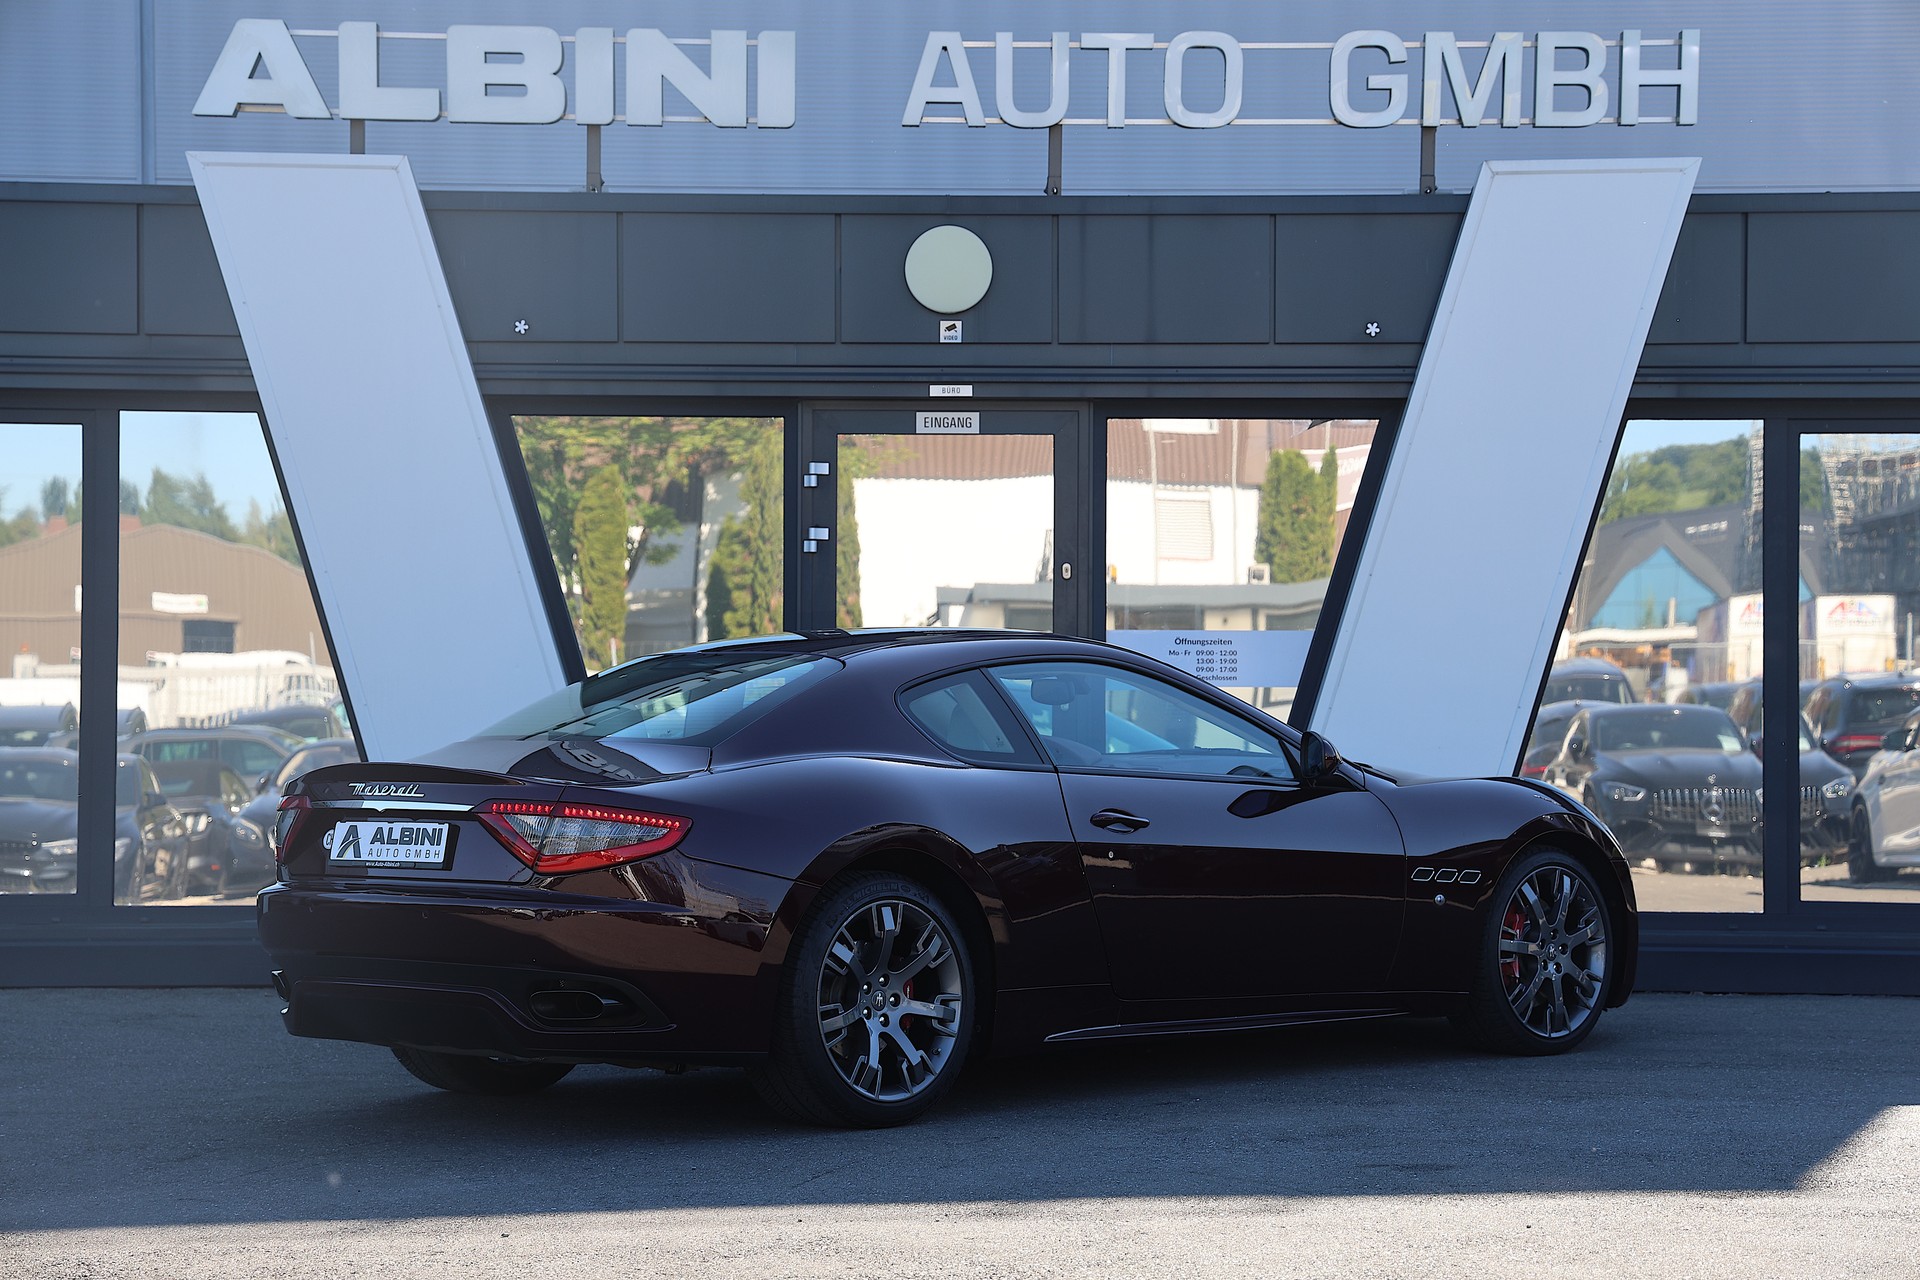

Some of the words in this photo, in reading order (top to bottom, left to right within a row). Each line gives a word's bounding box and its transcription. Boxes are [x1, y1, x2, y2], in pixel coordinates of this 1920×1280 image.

[192, 18, 796, 129] ALBINI
[902, 30, 1243, 129] AUTO
[1329, 29, 1701, 128] GMBH
[924, 417, 972, 428] EINGANG
[1174, 637, 1232, 646] Öffnungszeiten
[349, 783, 424, 797] Maserati
[370, 827, 443, 846] ALBINI
[367, 848, 399, 858] AUTO
[405, 848, 440, 859] GMBH
[853, 882, 900, 899] MICHELIN
